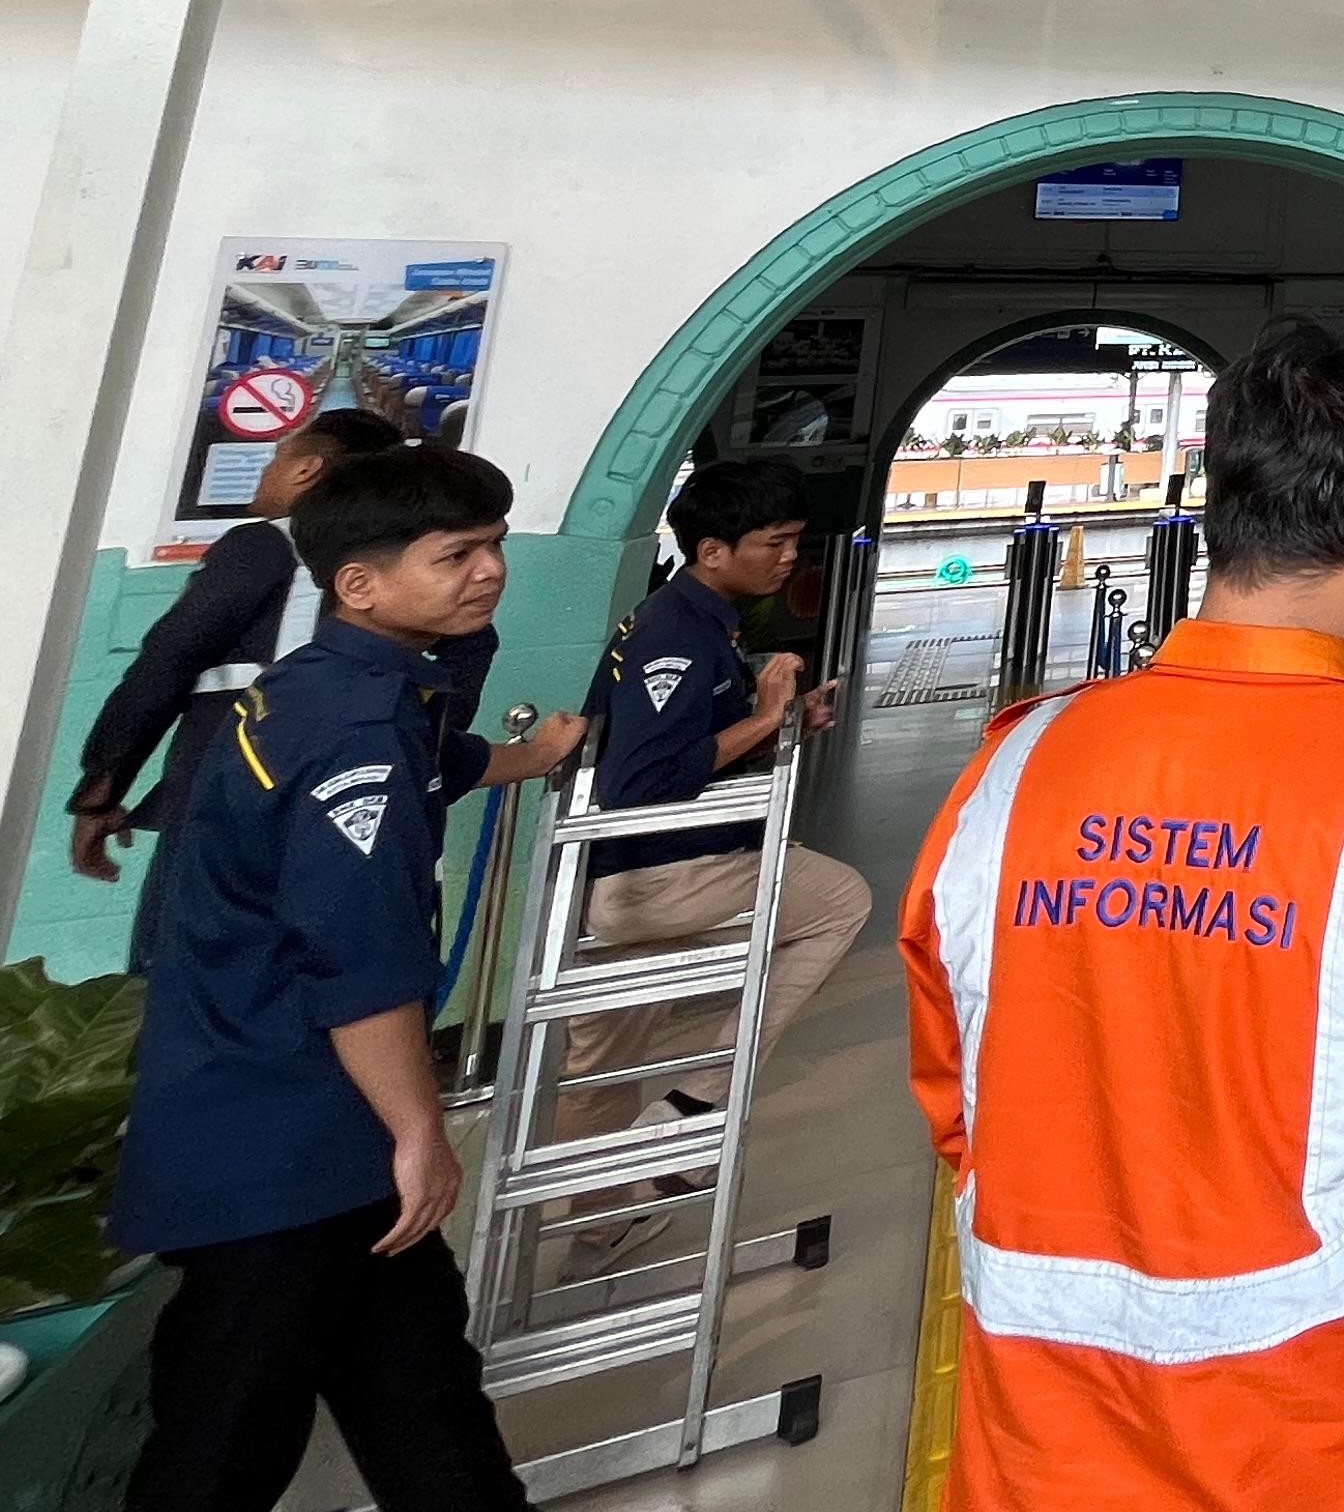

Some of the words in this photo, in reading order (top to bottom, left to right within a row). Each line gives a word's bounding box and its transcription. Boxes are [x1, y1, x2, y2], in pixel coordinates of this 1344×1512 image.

[235, 253, 288, 270] KAI
[1075, 814, 1262, 869] SISTEM
[1013, 878, 1297, 949] INFORMASI
